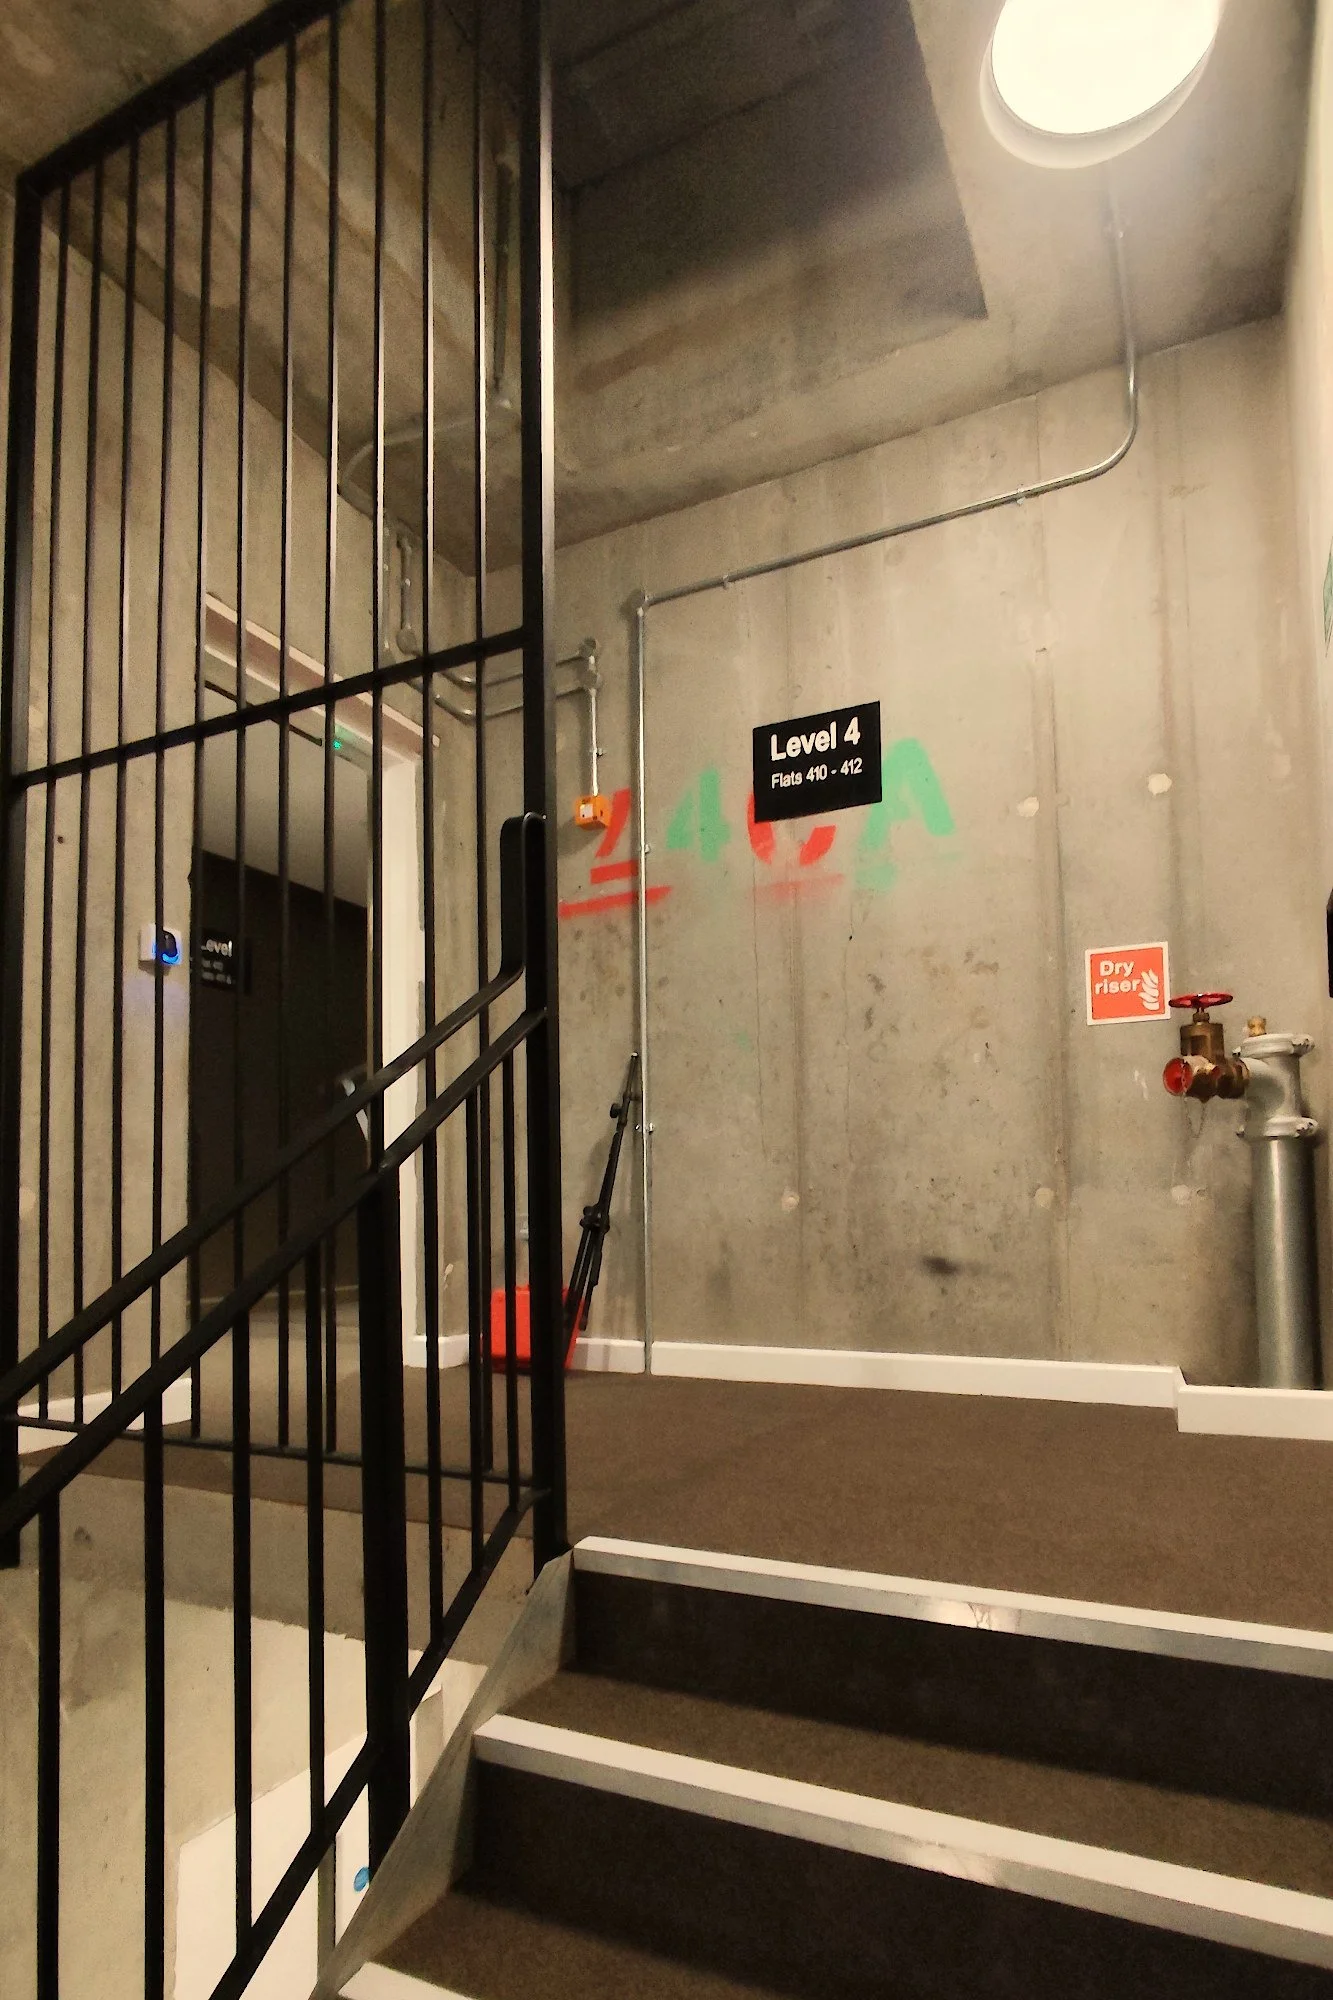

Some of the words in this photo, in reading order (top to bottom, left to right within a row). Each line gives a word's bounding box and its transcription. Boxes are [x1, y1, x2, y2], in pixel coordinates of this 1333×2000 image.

[770, 720, 837, 762] Level
[843, 716, 861, 745] 4
[771, 771, 803, 789] Flats
[807, 764, 828, 783] 410
[840, 757, 863, 776] 412
[1100, 960, 1135, 978] Dry
[1095, 978, 1141, 995] riser
